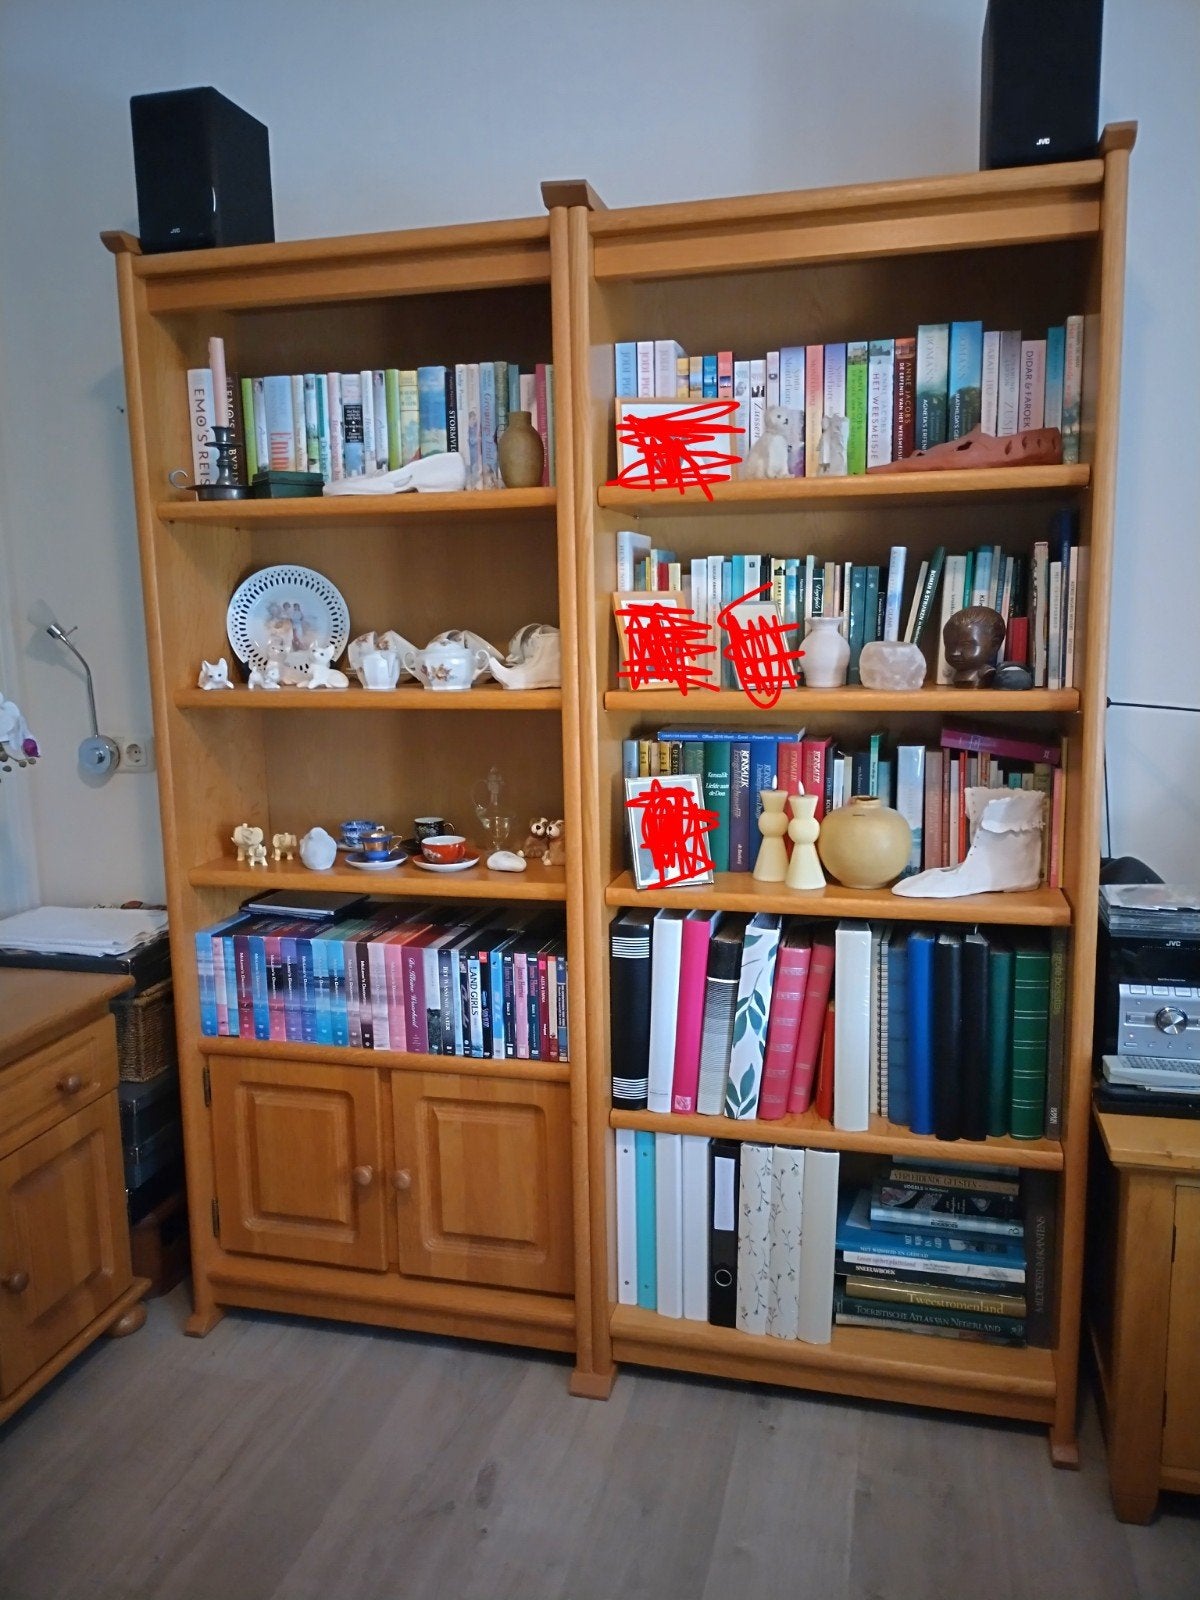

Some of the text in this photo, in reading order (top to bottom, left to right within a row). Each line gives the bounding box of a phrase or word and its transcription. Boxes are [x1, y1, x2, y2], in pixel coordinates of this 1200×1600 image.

[621, 351, 632, 375] JODI
[639, 351, 650, 375] JODI
[899, 362, 904, 370] DE
[1025, 351, 1034, 380] DIDAR
[194, 388, 209, 442] EMO'S
[1023, 392, 1032, 428] FAROEK
[871, 396, 879, 459] WEESMEISJE
[741, 749, 750, 788] KONSALIK
[408, 957, 416, 967] De
[470, 967, 480, 1016] LAND GIRLS
[906, 1293, 1005, 1315] Tweestromenland
[855, 1304, 906, 1320] TOERISTISCHE
[951, 1317, 1002, 1334] NEDERLAND
